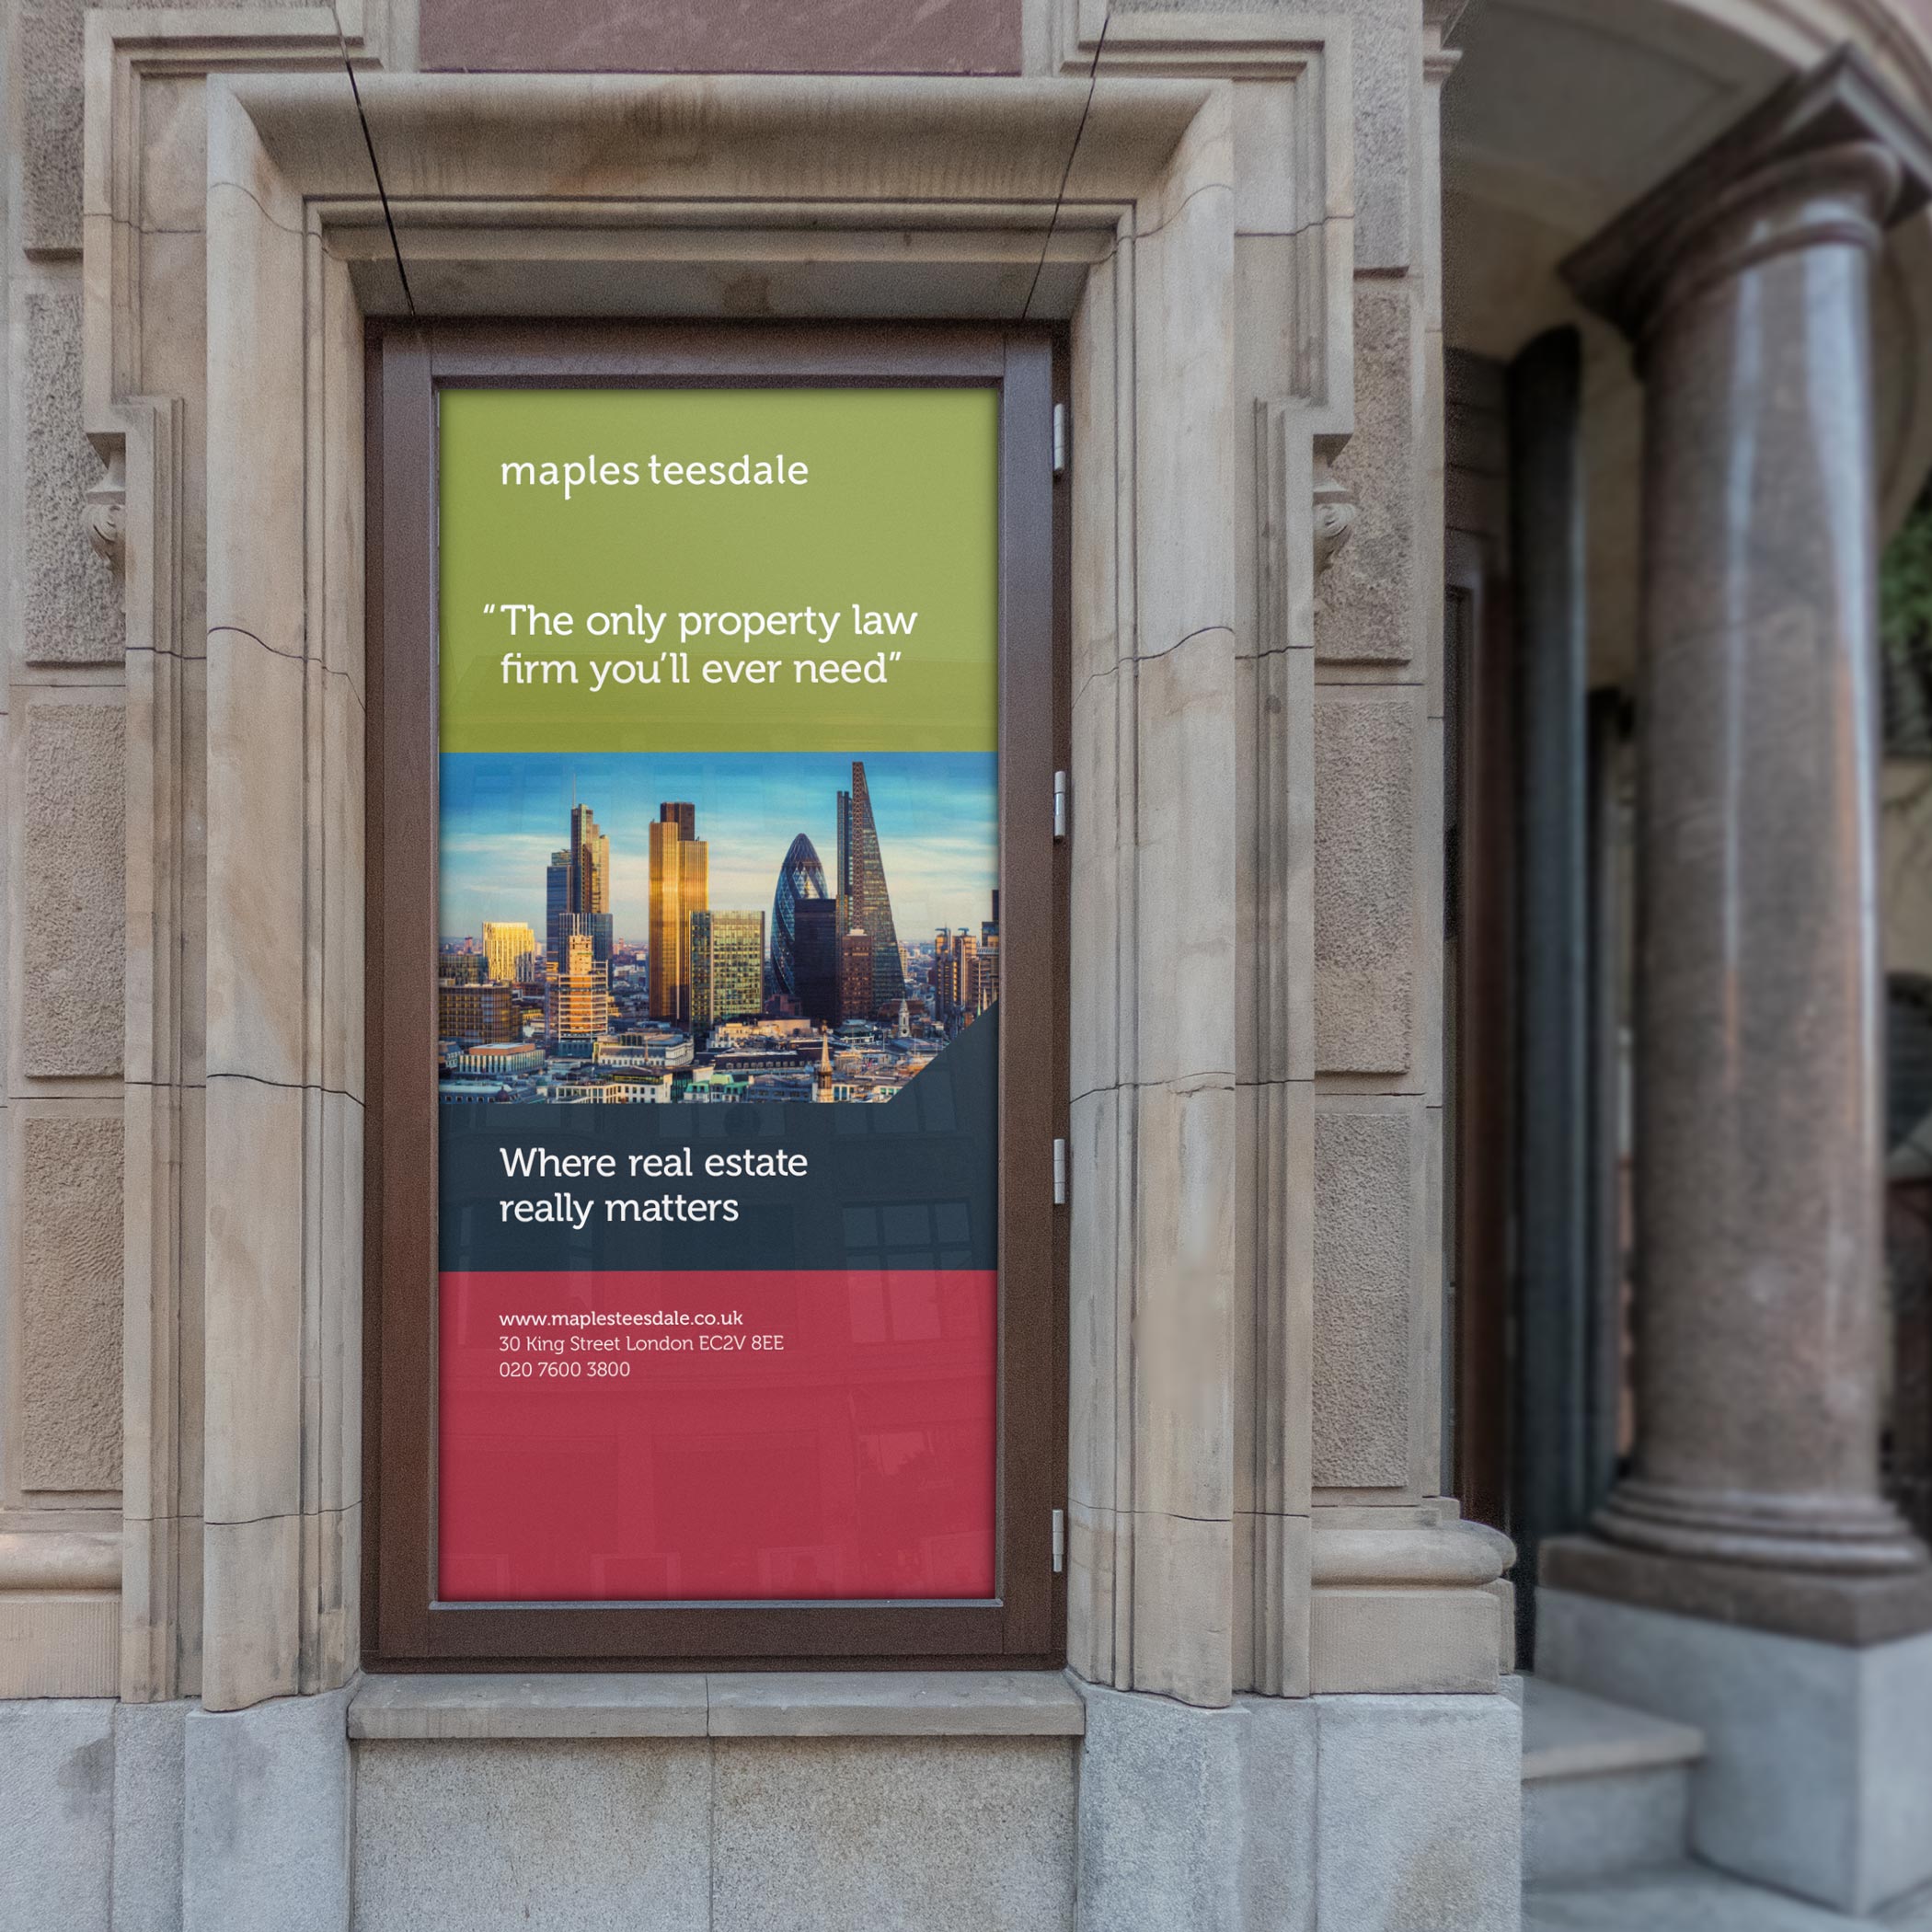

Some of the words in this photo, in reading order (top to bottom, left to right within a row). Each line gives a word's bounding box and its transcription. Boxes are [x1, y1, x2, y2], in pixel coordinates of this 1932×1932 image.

[500, 454, 640, 500] maples
[647, 454, 809, 486] teesdale
[586, 604, 667, 644] only
[678, 605, 842, 644] property
[851, 603, 919, 636] law
[500, 652, 579, 684] firm
[702, 660, 783, 684] ever
[499, 1146, 616, 1178] Where
[627, 1146, 694, 1178] real
[704, 1148, 809, 1178] estate
[499, 1191, 595, 1231] really
[604, 1193, 740, 1223] matters
[499, 1309, 743, 1330] www.maplesteesdale.co.uk
[499, 1335, 521, 1352] 30
[526, 1335, 566, 1355] King
[569, 1335, 621, 1351] Street
[626, 1335, 695, 1351] London
[698, 1334, 747, 1351] EC2V
[751, 1334, 785, 1351] 8EE
[499, 1362, 533, 1378] 020
[537, 1361, 581, 1377] 7600
[586, 1361, 631, 1377] 3800
